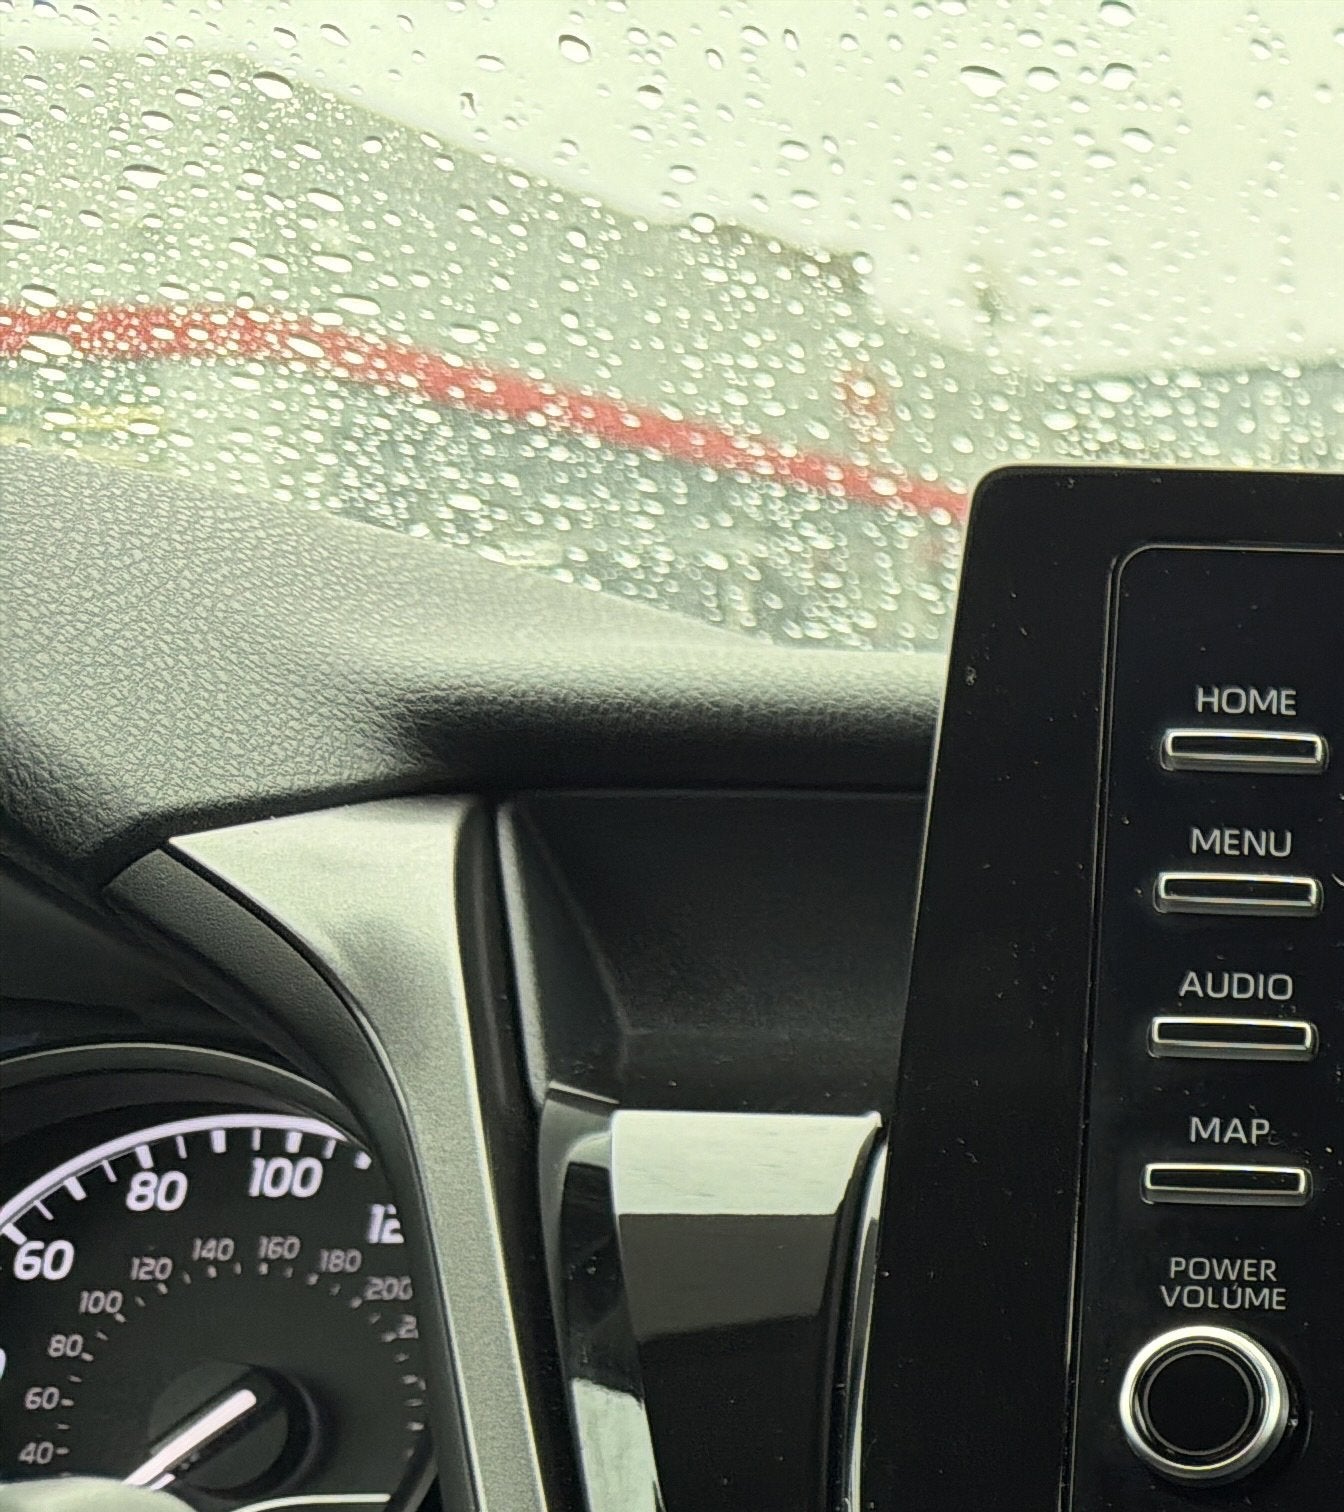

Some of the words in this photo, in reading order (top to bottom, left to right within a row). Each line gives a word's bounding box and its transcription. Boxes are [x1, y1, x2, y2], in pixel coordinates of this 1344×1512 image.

[1194, 684, 1300, 716] HOME
[1188, 826, 1294, 858] MENU
[1178, 969, 1295, 1001] AUDIO
[1188, 1115, 1272, 1145] MAP
[126, 1170, 188, 1212] 80
[249, 1156, 323, 1199] 100
[366, 1202, 405, 1245] 12
[13, 1239, 75, 1281] 60
[191, 1236, 236, 1262] 140
[258, 1235, 301, 1262] 160
[319, 1248, 363, 1275] 180
[129, 1256, 174, 1282] 120
[1168, 1256, 1278, 1283] POWER
[78, 1290, 124, 1316] 100
[1160, 1284, 1288, 1313] VOLUME
[47, 1334, 84, 1358] 80
[24, 1386, 61, 1411] 60
[18, 1440, 56, 1465] 40
